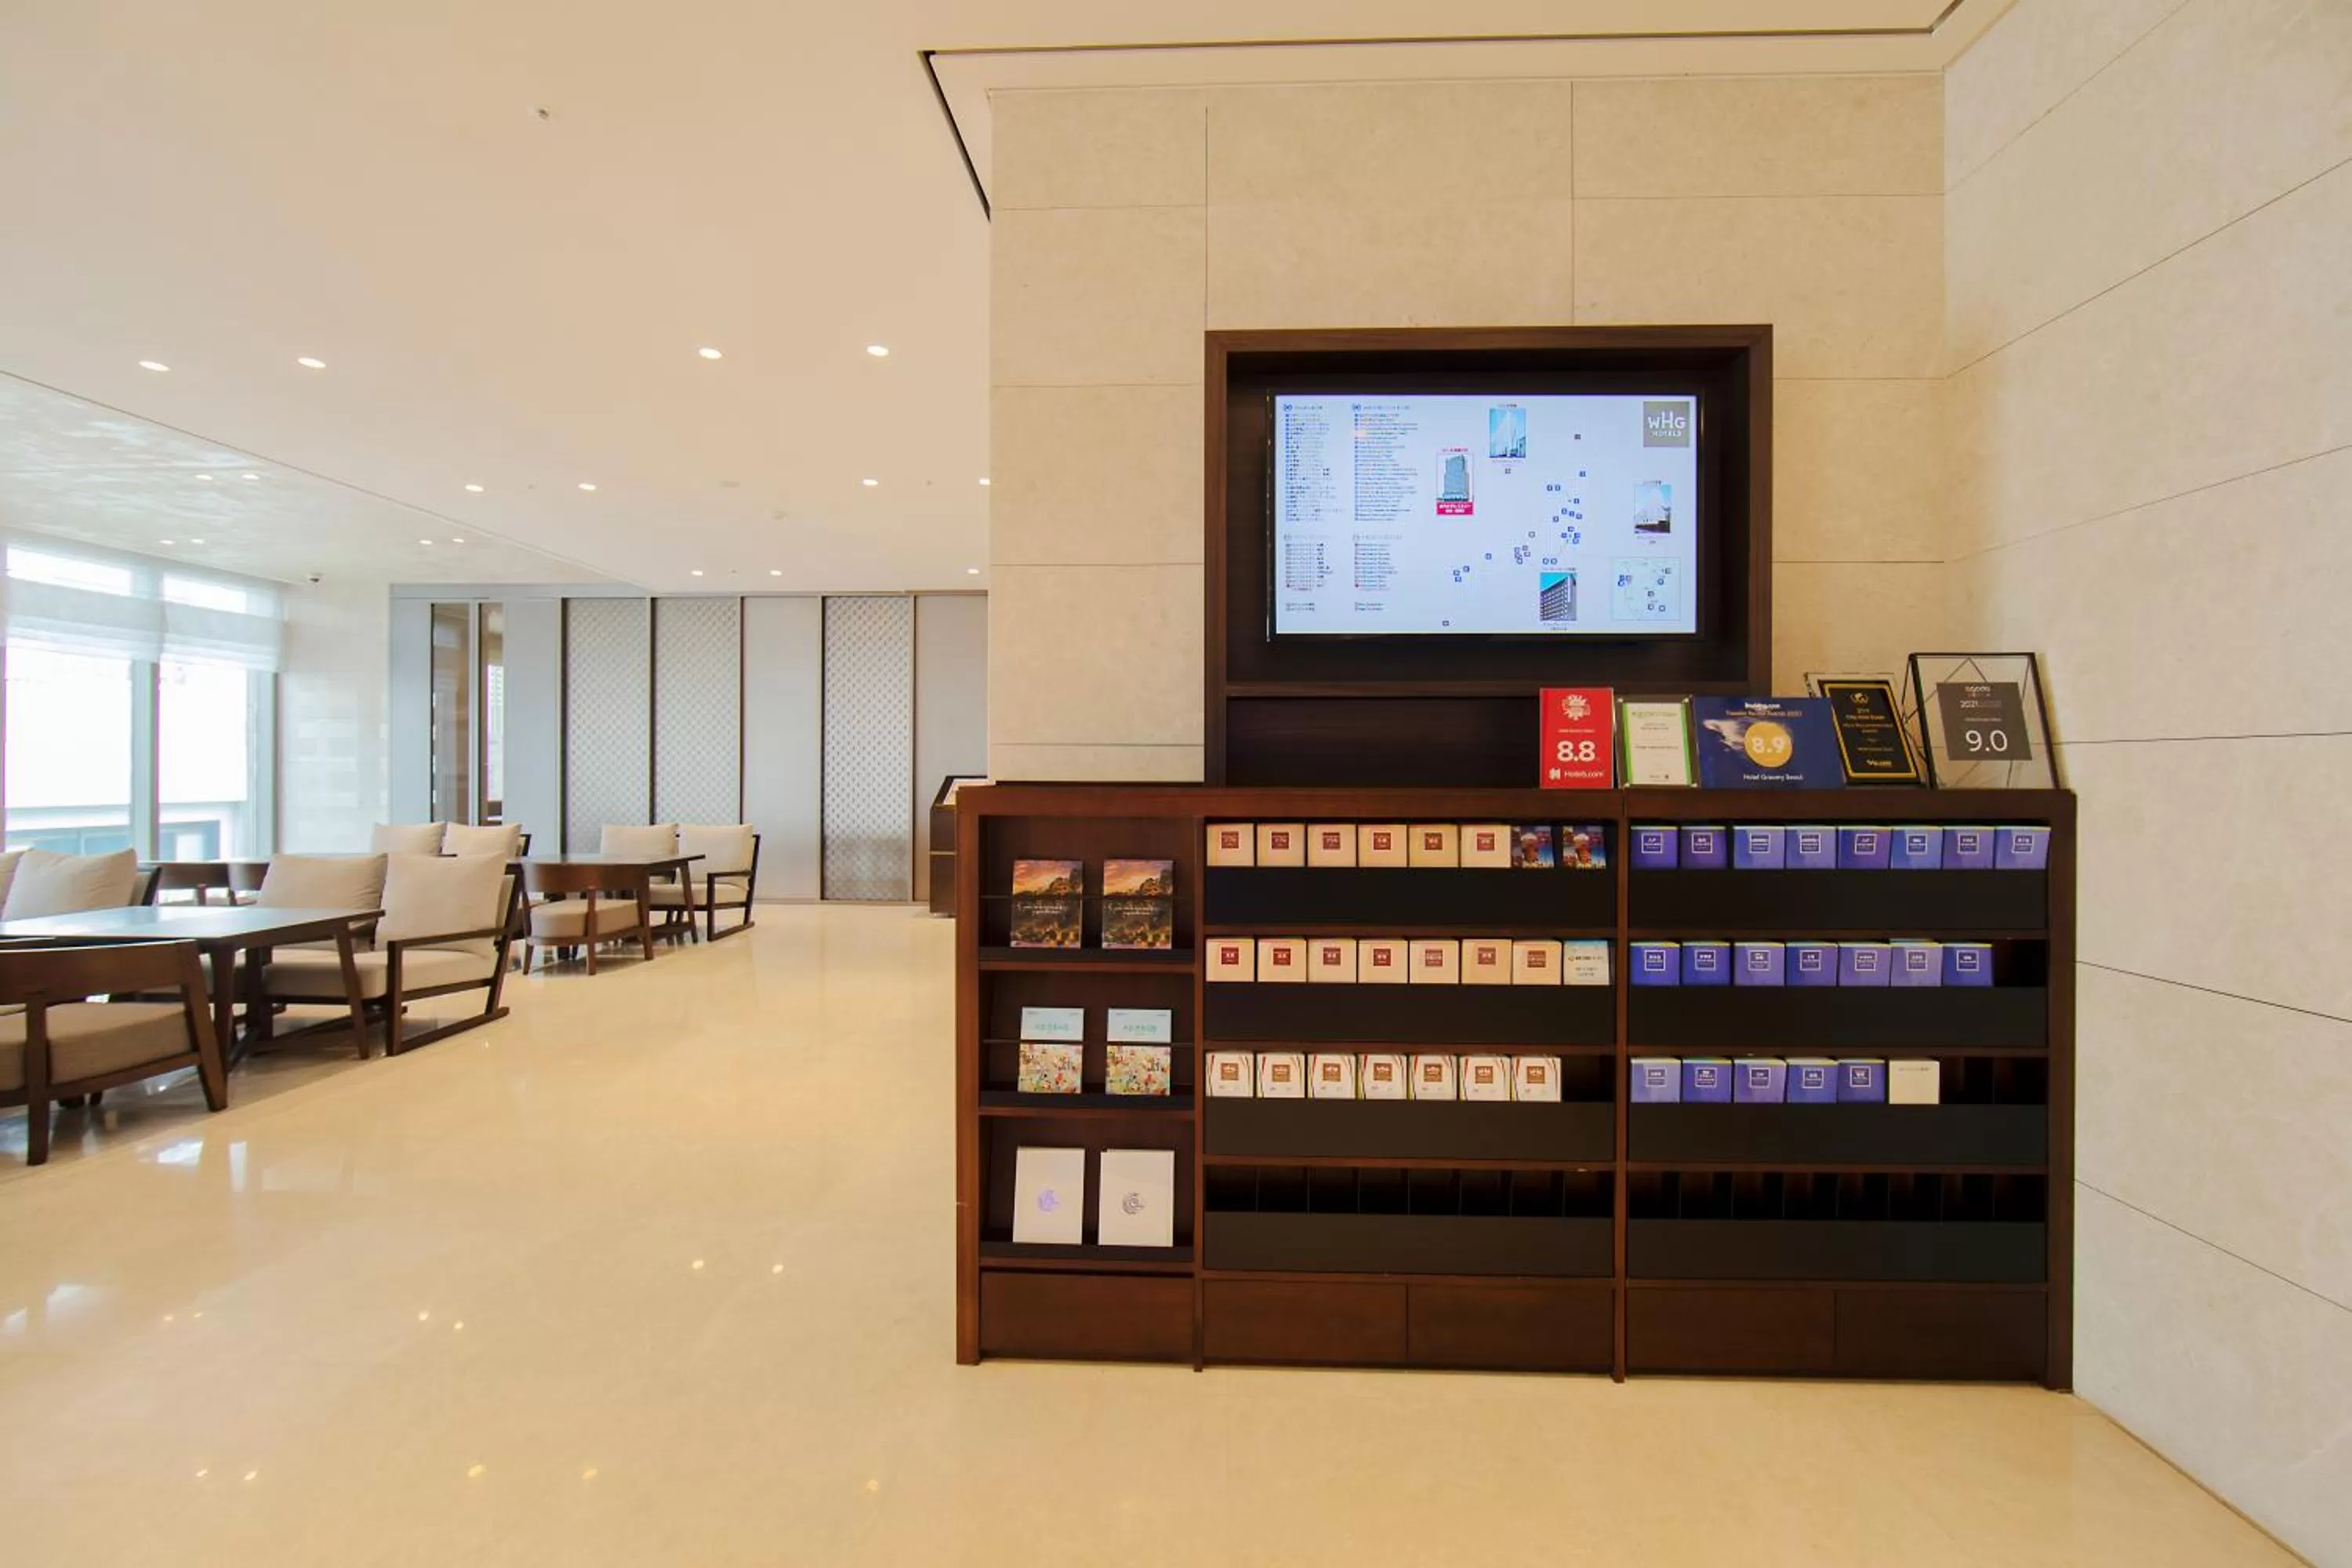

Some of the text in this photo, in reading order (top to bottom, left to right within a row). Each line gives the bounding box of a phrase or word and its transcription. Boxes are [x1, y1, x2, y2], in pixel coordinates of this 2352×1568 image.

[1557, 740, 1595, 762] 8.8
[1751, 736, 1784, 753] 8.9
[1965, 730, 2007, 752] 9.0
